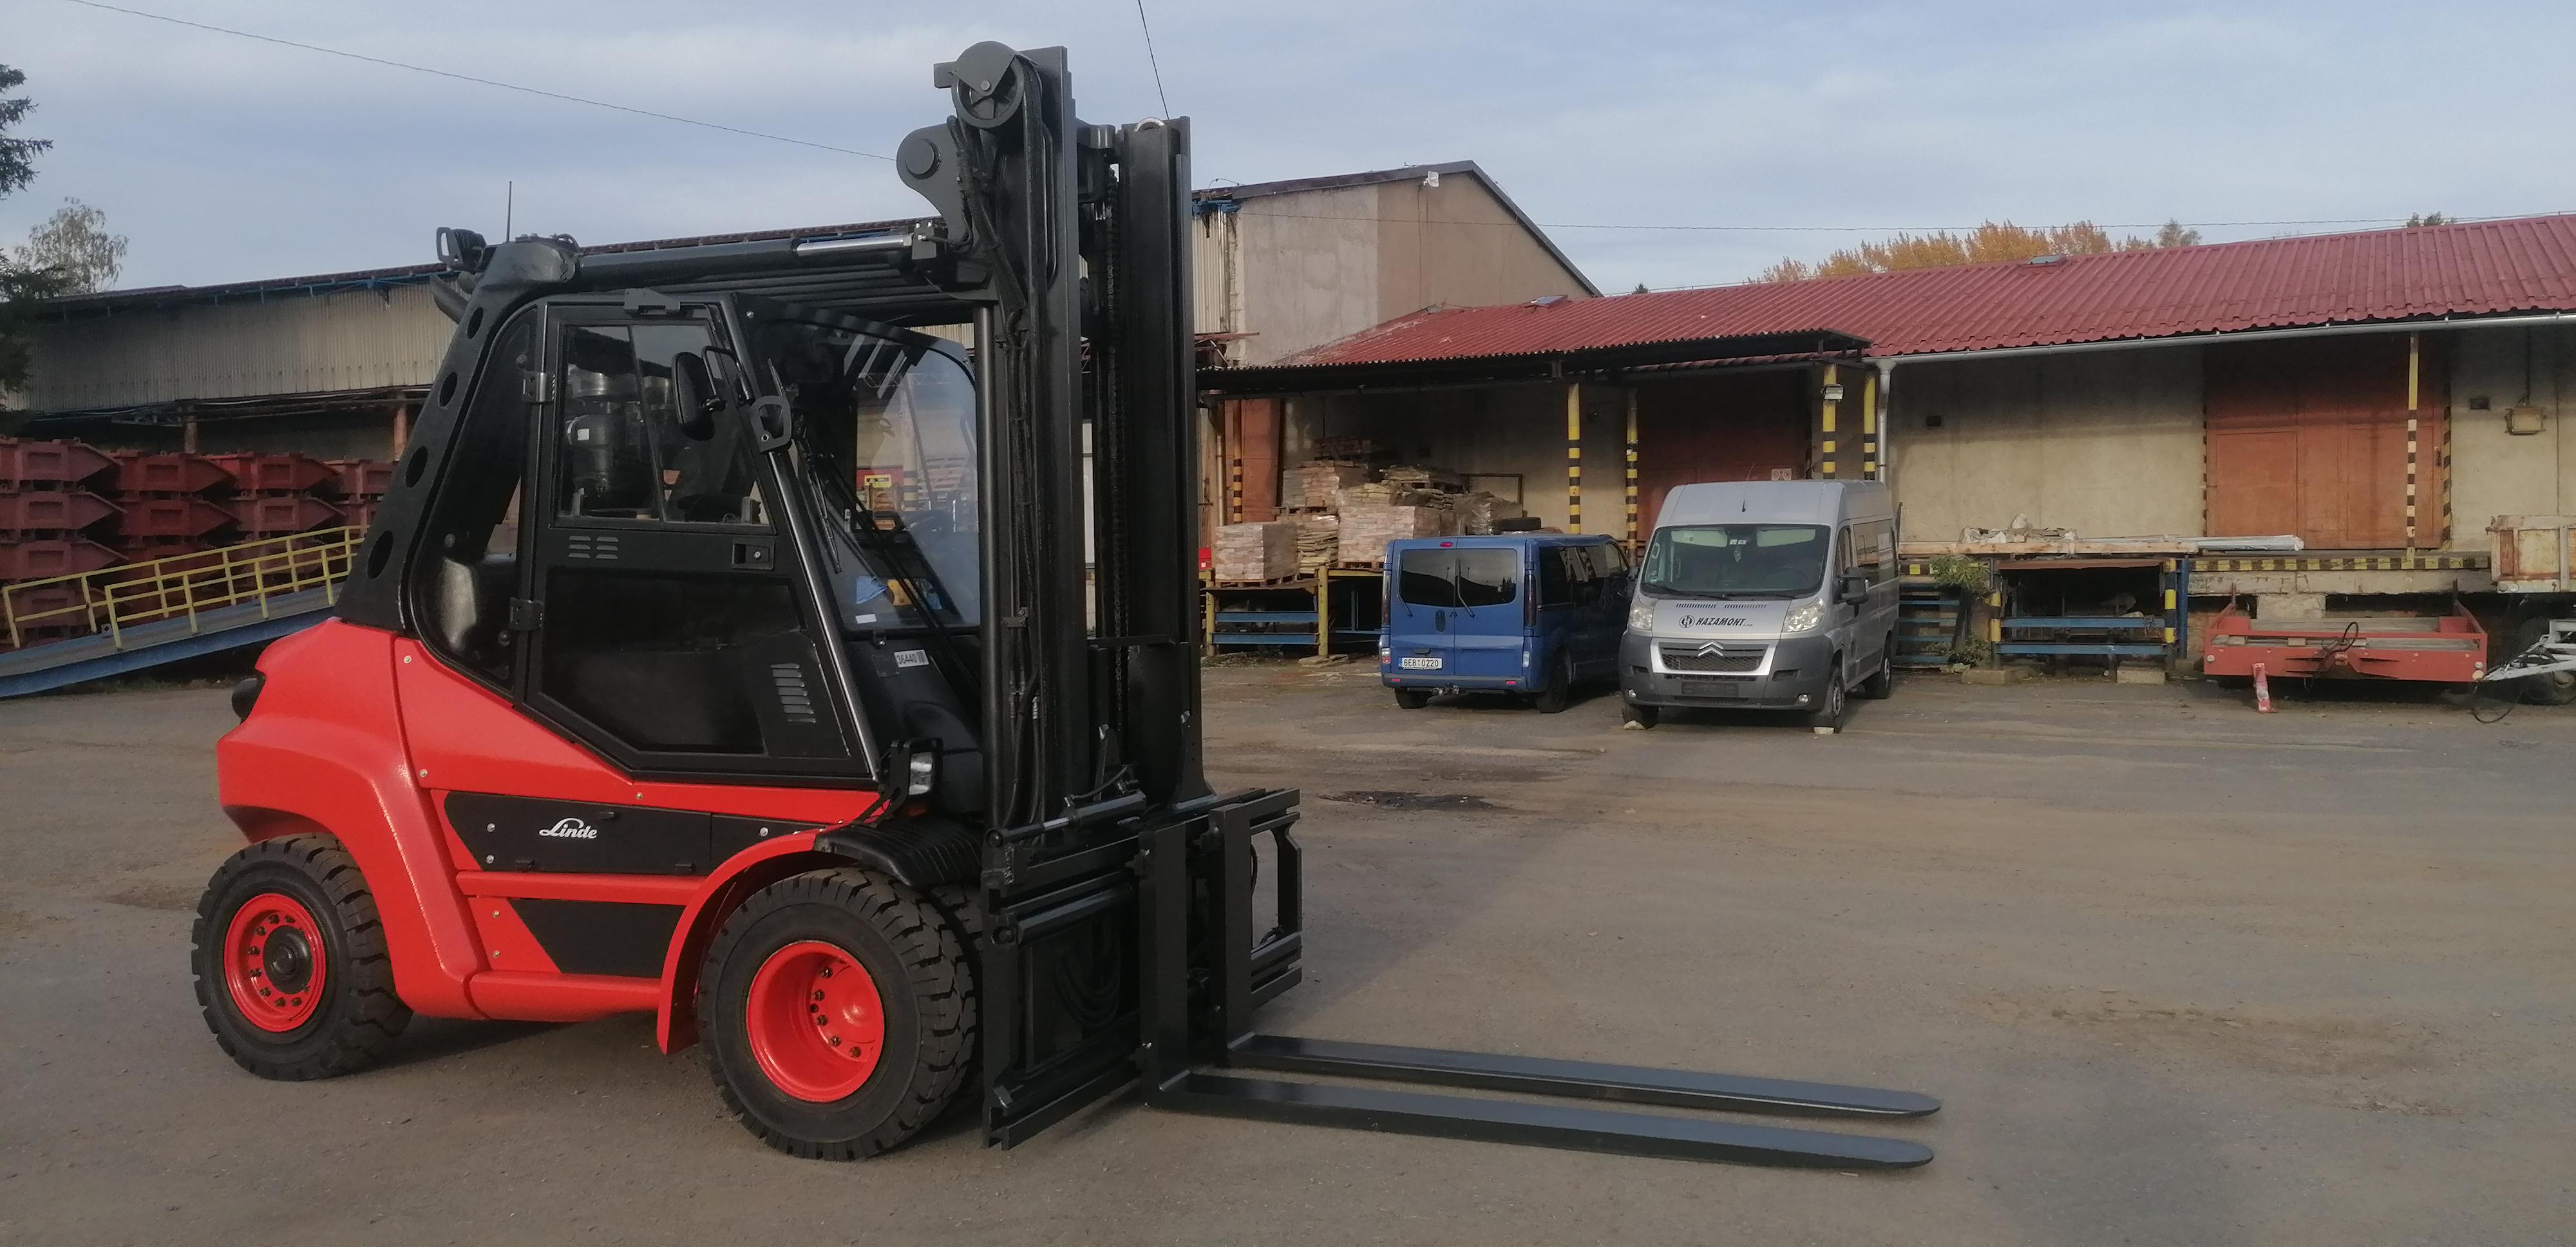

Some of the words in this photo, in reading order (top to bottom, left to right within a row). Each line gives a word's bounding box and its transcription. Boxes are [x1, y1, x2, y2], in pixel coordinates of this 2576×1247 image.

[1696, 618, 1746, 626] HAZAMONT
[1421, 659, 1439, 667] 0220
[538, 817, 598, 839] Linde
